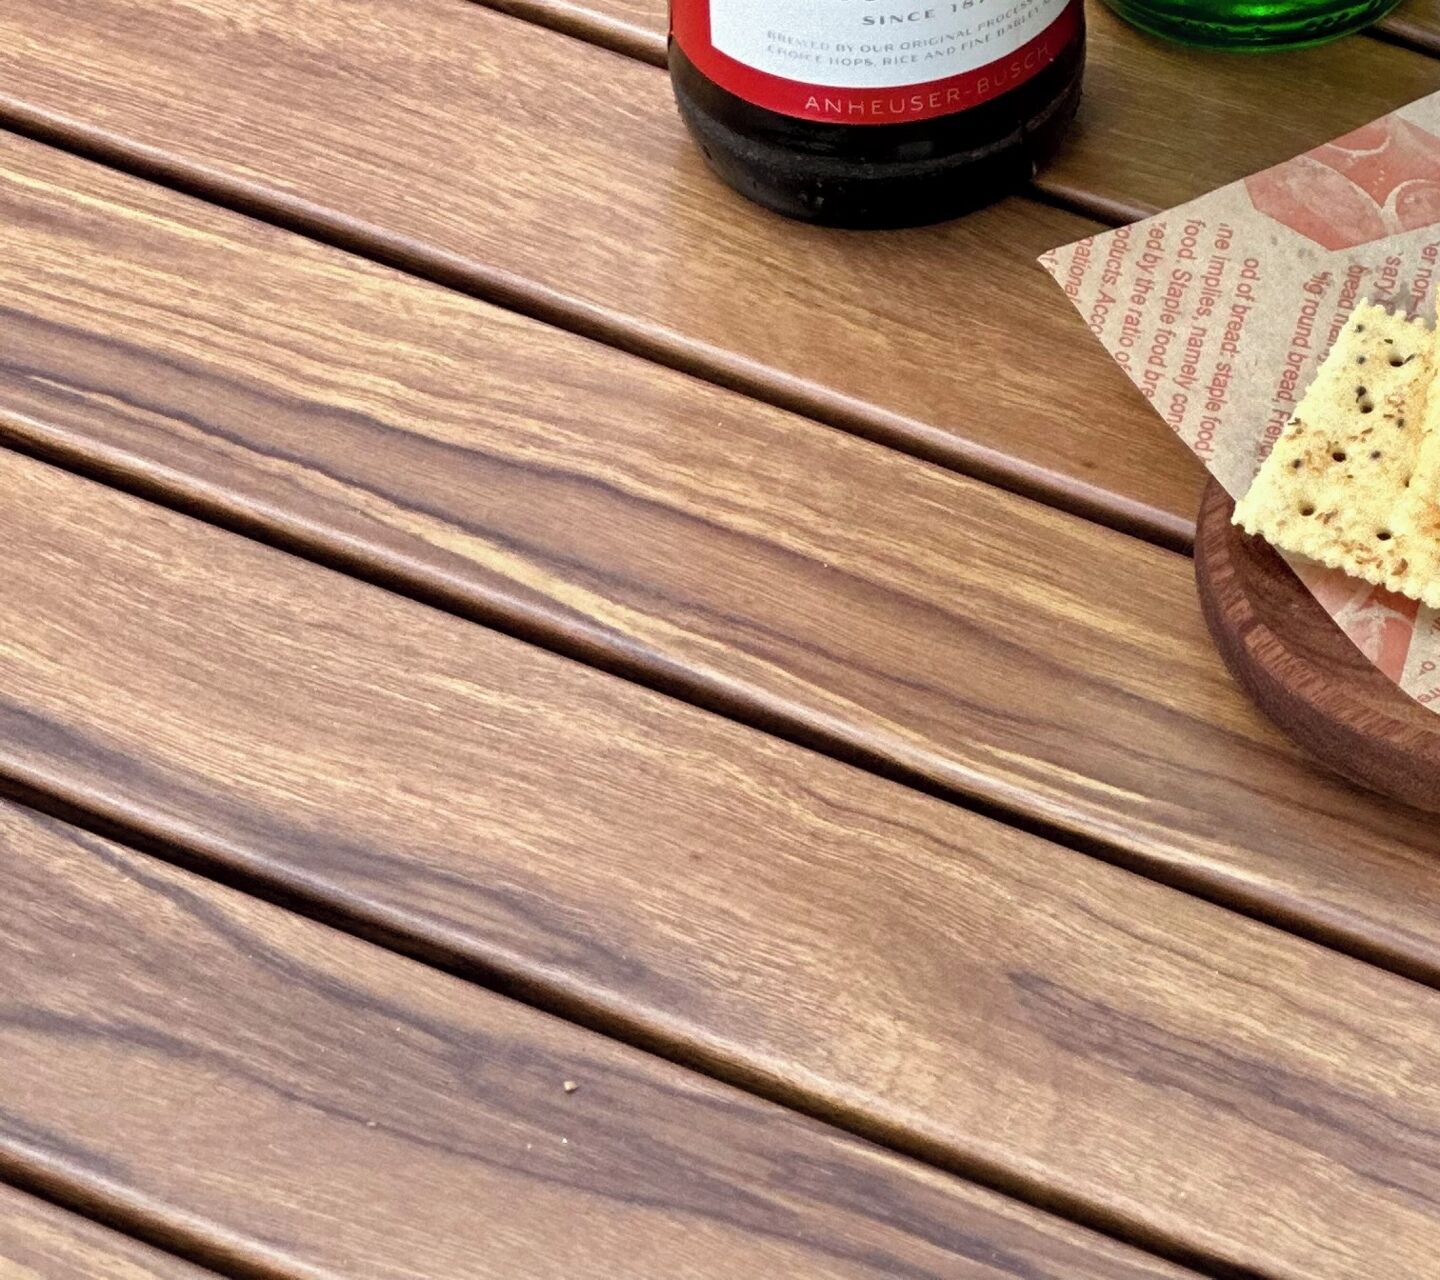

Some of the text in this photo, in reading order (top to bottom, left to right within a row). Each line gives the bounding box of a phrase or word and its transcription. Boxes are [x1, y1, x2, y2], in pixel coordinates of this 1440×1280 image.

[836, 44, 853, 53] BY
[860, 44, 894, 54] OUR
[900, 28, 972, 51] ORIGINAL
[861, 9, 936, 26] SINCE
[882, 53, 921, 65] RICE
[924, 46, 956, 60] AND
[961, 32, 990, 51] FINE
[804, 42, 1050, 116] ANHEUSER-BUSCH
[1118, 276, 1155, 348] the ratio
[1147, 219, 1207, 369] food. Staple food
[1172, 254, 1232, 391] implies, namely
[1271, 298, 1320, 410] round bread,
[1194, 361, 1234, 453] staple food
